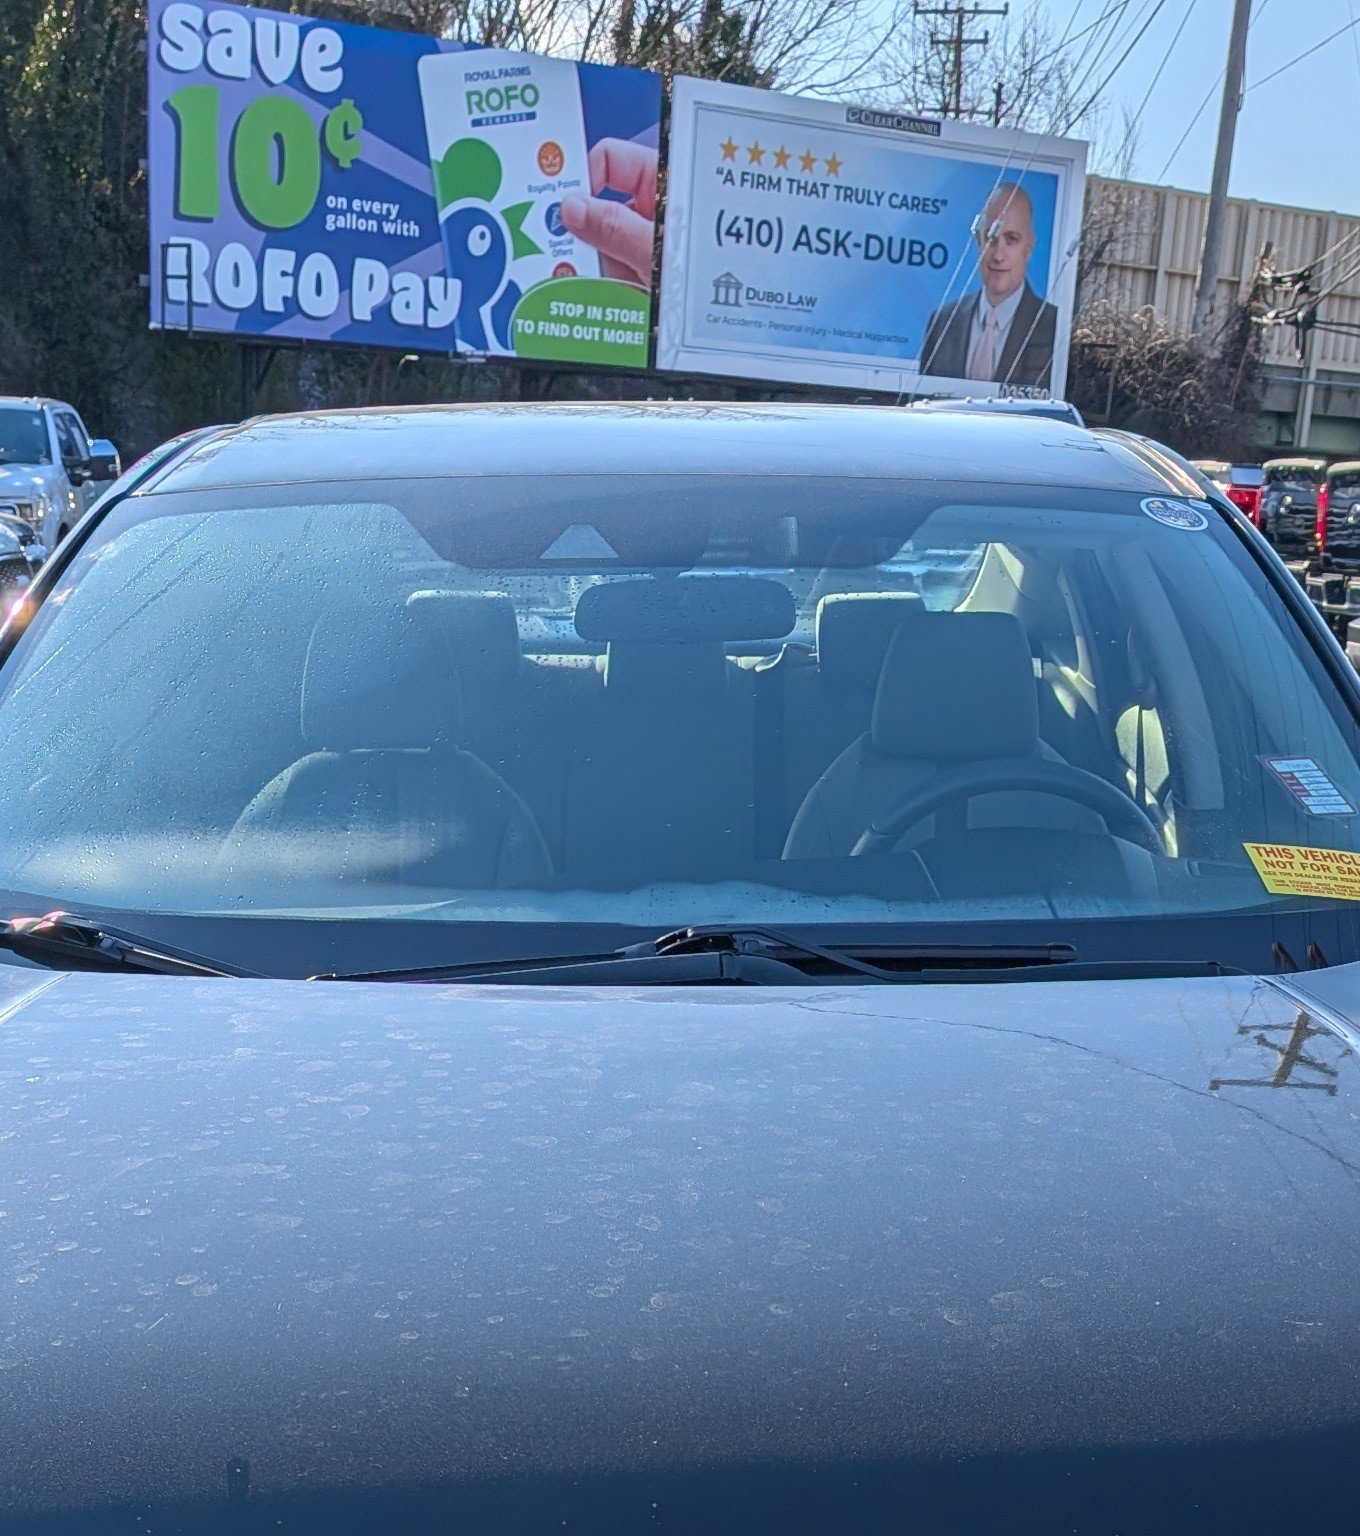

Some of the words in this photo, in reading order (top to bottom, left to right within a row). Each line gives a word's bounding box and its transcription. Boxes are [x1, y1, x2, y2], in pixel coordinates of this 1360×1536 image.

[466, 83, 540, 115] ROFO
[740, 171, 782, 193] FIRM
[786, 177, 830, 199] THAT
[833, 184, 885, 207] TRULY
[326, 195, 347, 210] on
[351, 199, 399, 219] every
[325, 213, 378, 232] gallon
[383, 218, 420, 238] with
[715, 208, 783, 254] (410)
[792, 224, 949, 270] ASK-DUBO
[166, 236, 340, 318] ROFO
[352, 257, 462, 329] Pay
[549, 301, 584, 318] STOP
[587, 305, 602, 320] IN
[604, 307, 645, 324] STORE
[517, 319, 535, 334] TO
[537, 321, 570, 337] FIND
[572, 324, 601, 341] OUT
[603, 328, 645, 345] MORE!
[1251, 845, 1295, 860] THIS
[1264, 859, 1294, 870] NOT
[1299, 861, 1332, 874] FOR
[1294, 872, 1323, 880] DEALER
